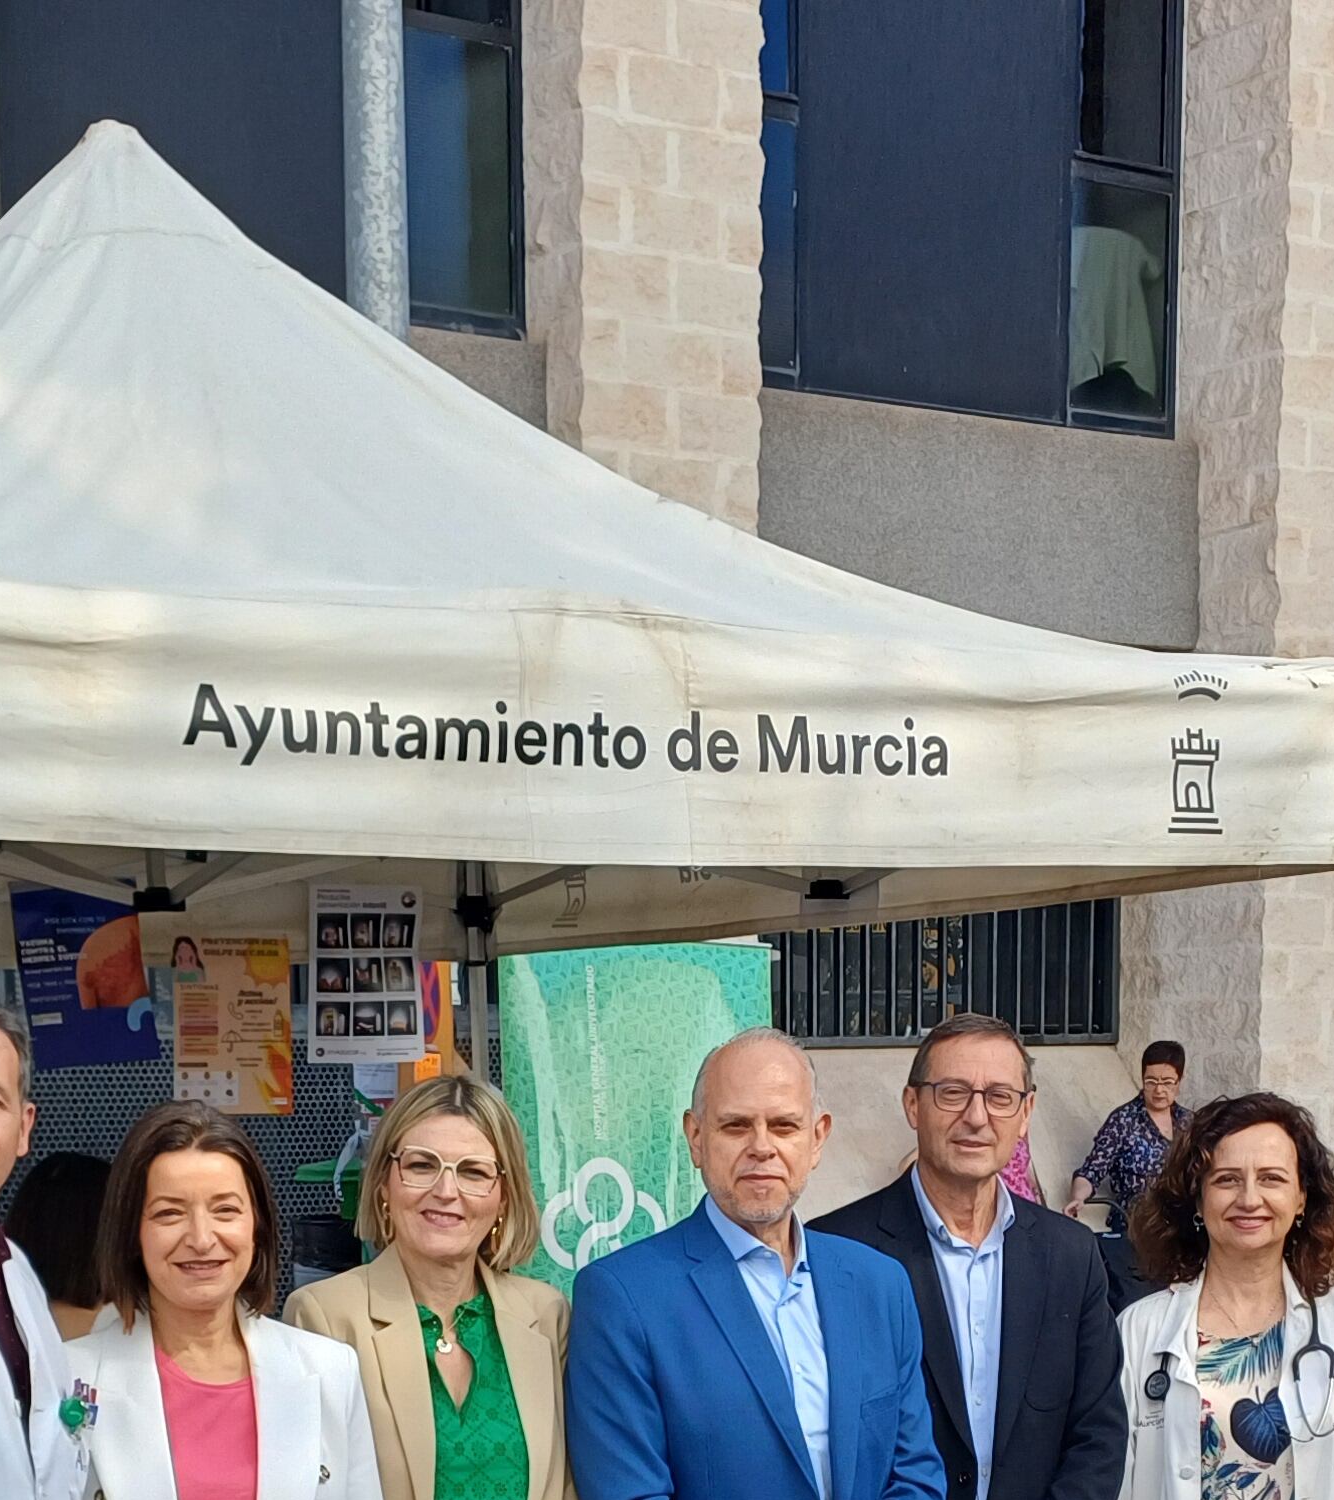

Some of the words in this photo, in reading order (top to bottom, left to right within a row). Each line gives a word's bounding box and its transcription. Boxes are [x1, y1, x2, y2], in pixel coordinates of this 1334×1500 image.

[182, 683, 648, 769] Ayuntamiento
[667, 711, 739, 773] de
[757, 714, 950, 777] Murcia
